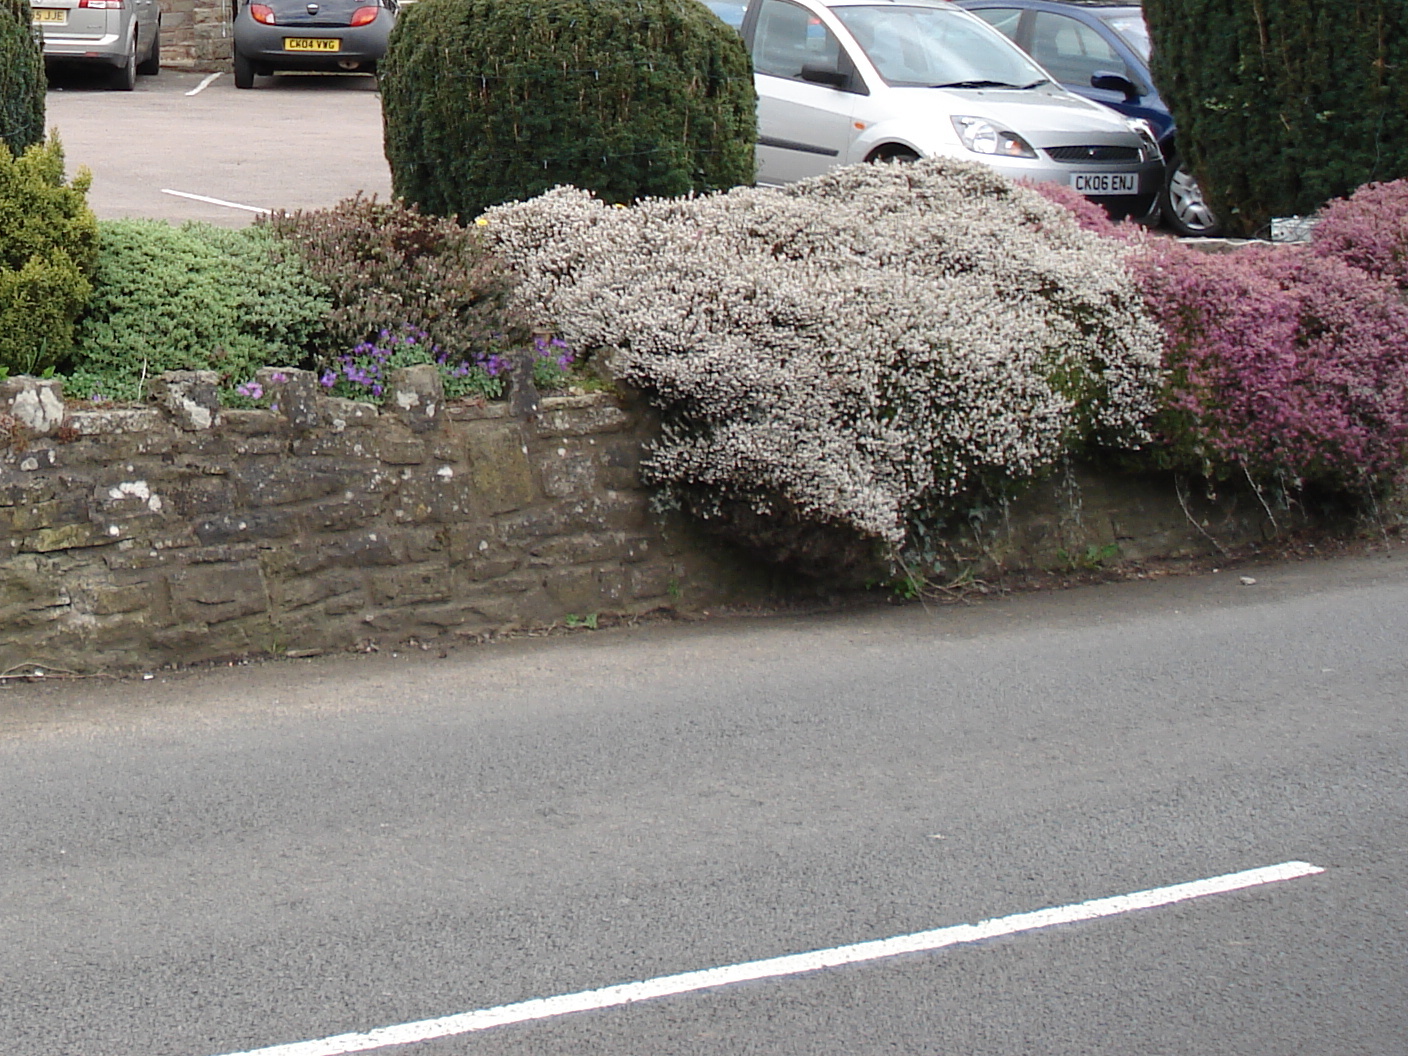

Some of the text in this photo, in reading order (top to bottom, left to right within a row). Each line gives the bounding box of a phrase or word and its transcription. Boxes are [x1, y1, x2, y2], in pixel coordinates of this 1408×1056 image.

[44, 10, 65, 21] JJE
[1075, 175, 1134, 191] CK06 ENJ
